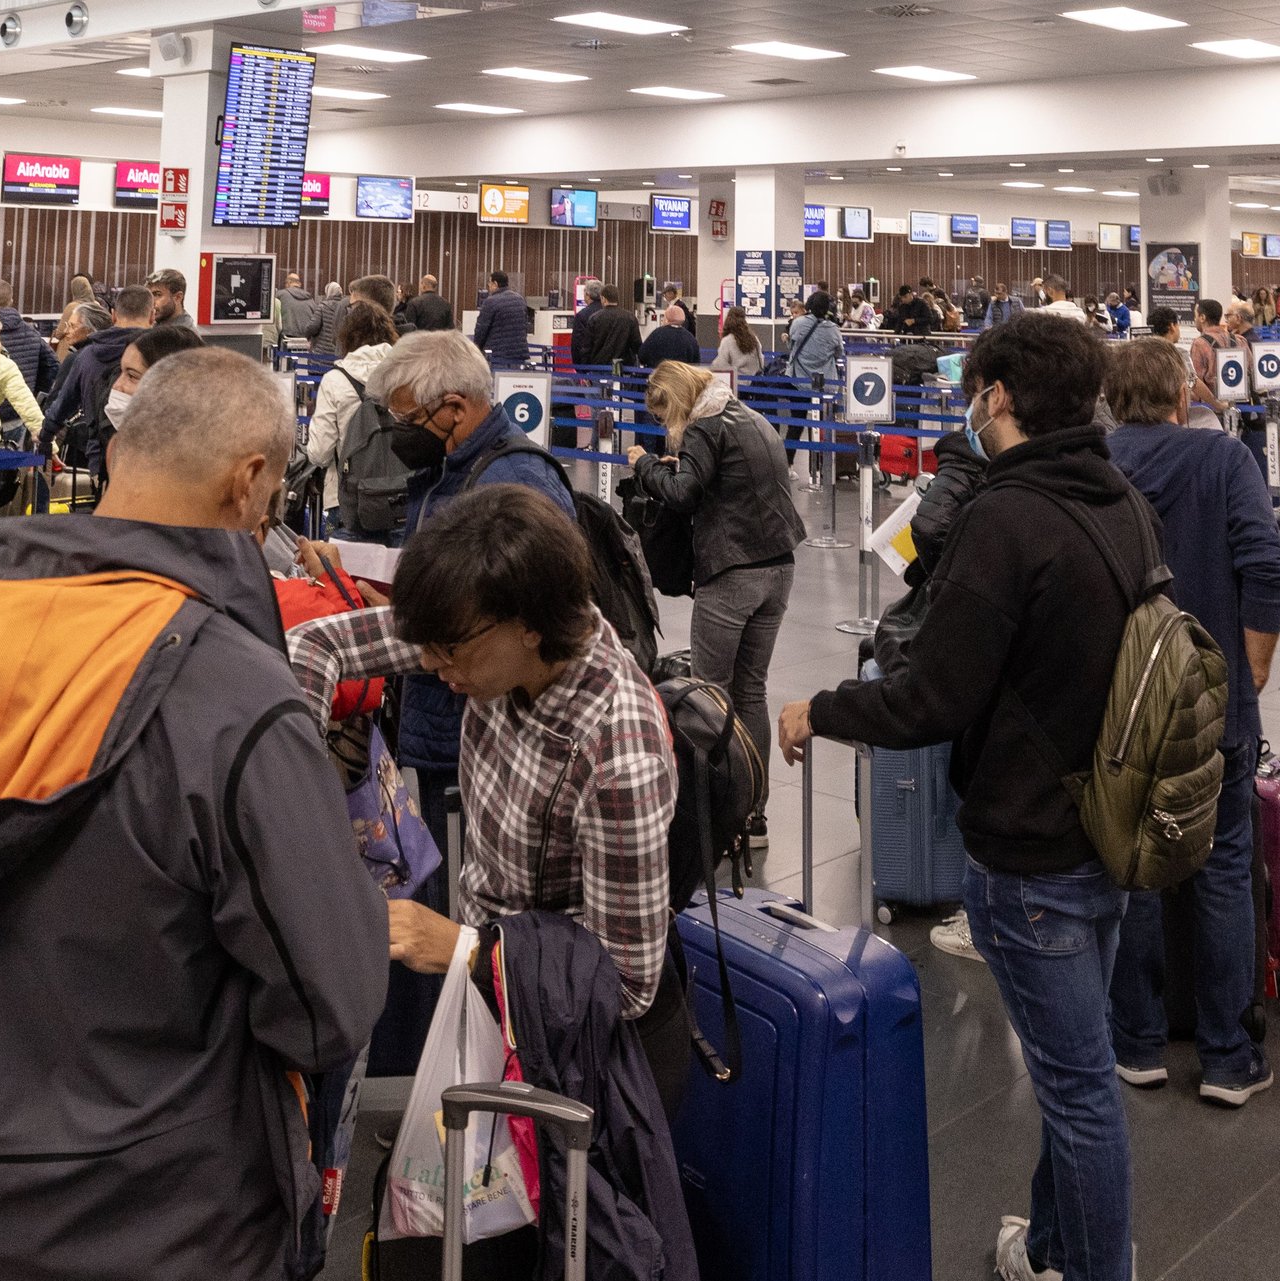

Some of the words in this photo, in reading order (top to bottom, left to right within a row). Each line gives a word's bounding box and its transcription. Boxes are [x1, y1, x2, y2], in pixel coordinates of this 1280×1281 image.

[17, 162, 70, 179] AirArabia
[416, 192, 430, 208] 12
[456, 196, 469, 211] 13
[659, 198, 689, 213] RYANAIR
[599, 204, 609, 218] 14
[631, 206, 642, 220] 15
[1228, 367, 1236, 381] 9
[1261, 360, 1278, 373] 10
[864, 381, 876, 397] 7
[515, 403, 529, 422] 6
